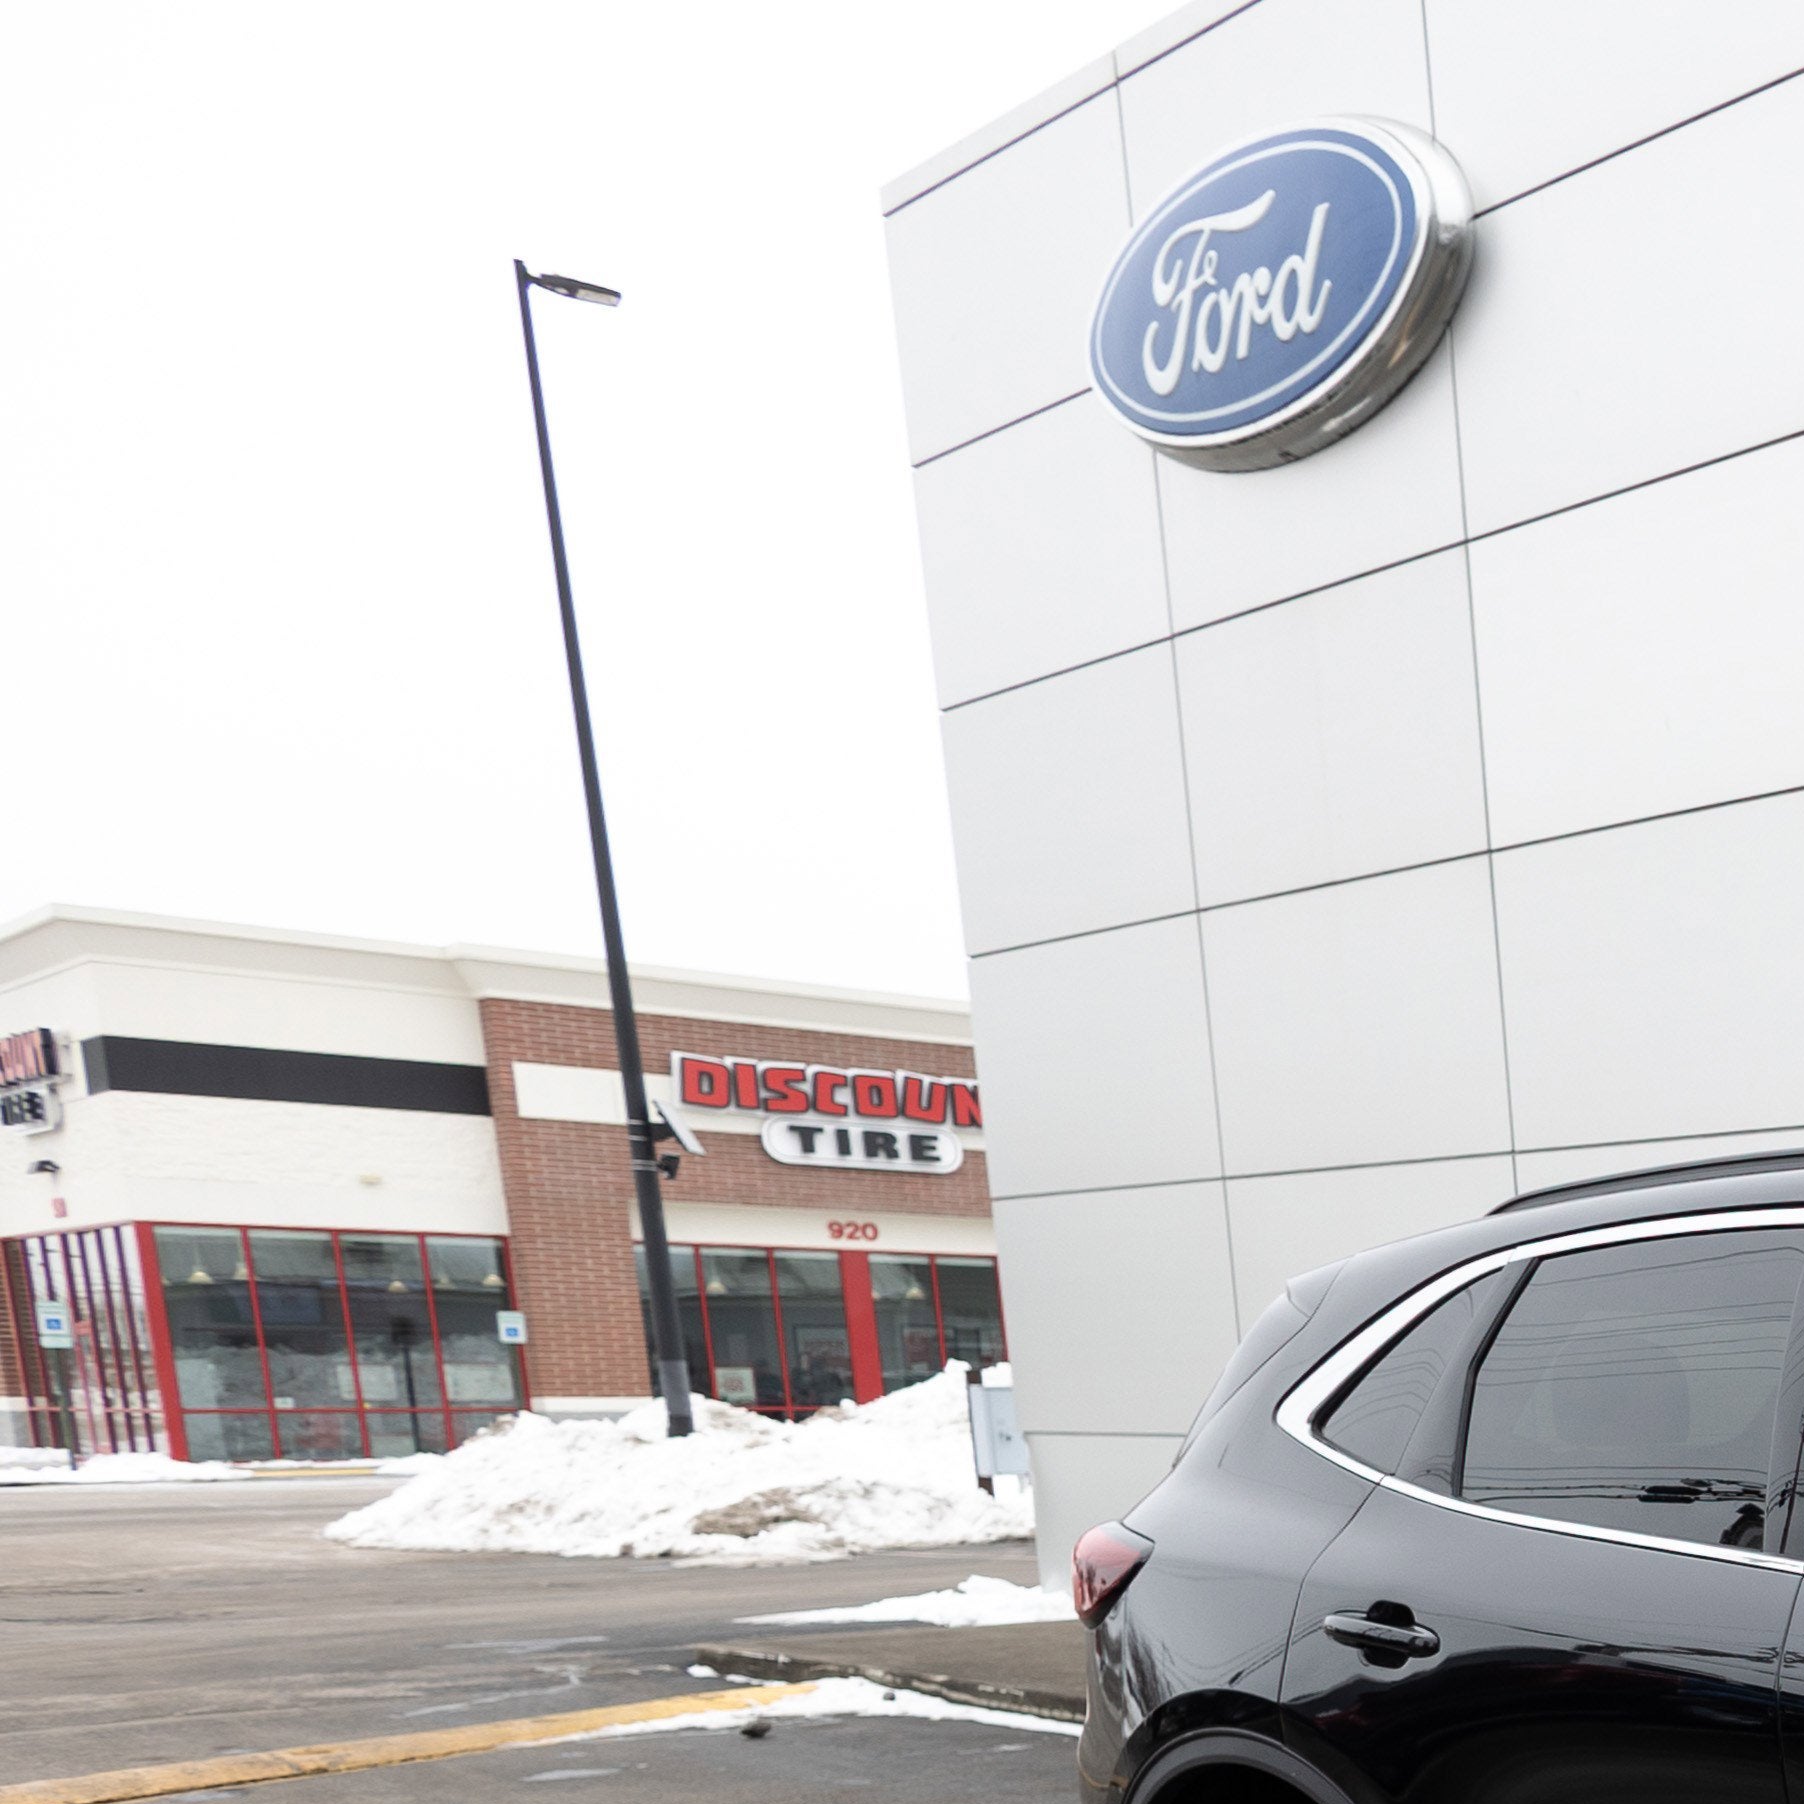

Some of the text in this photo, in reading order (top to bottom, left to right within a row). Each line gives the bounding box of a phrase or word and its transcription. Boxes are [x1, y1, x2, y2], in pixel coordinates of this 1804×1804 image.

[1142, 188, 1332, 396] Ford
[788, 1125, 942, 1162] TIRE
[827, 1220, 879, 1242] 920
